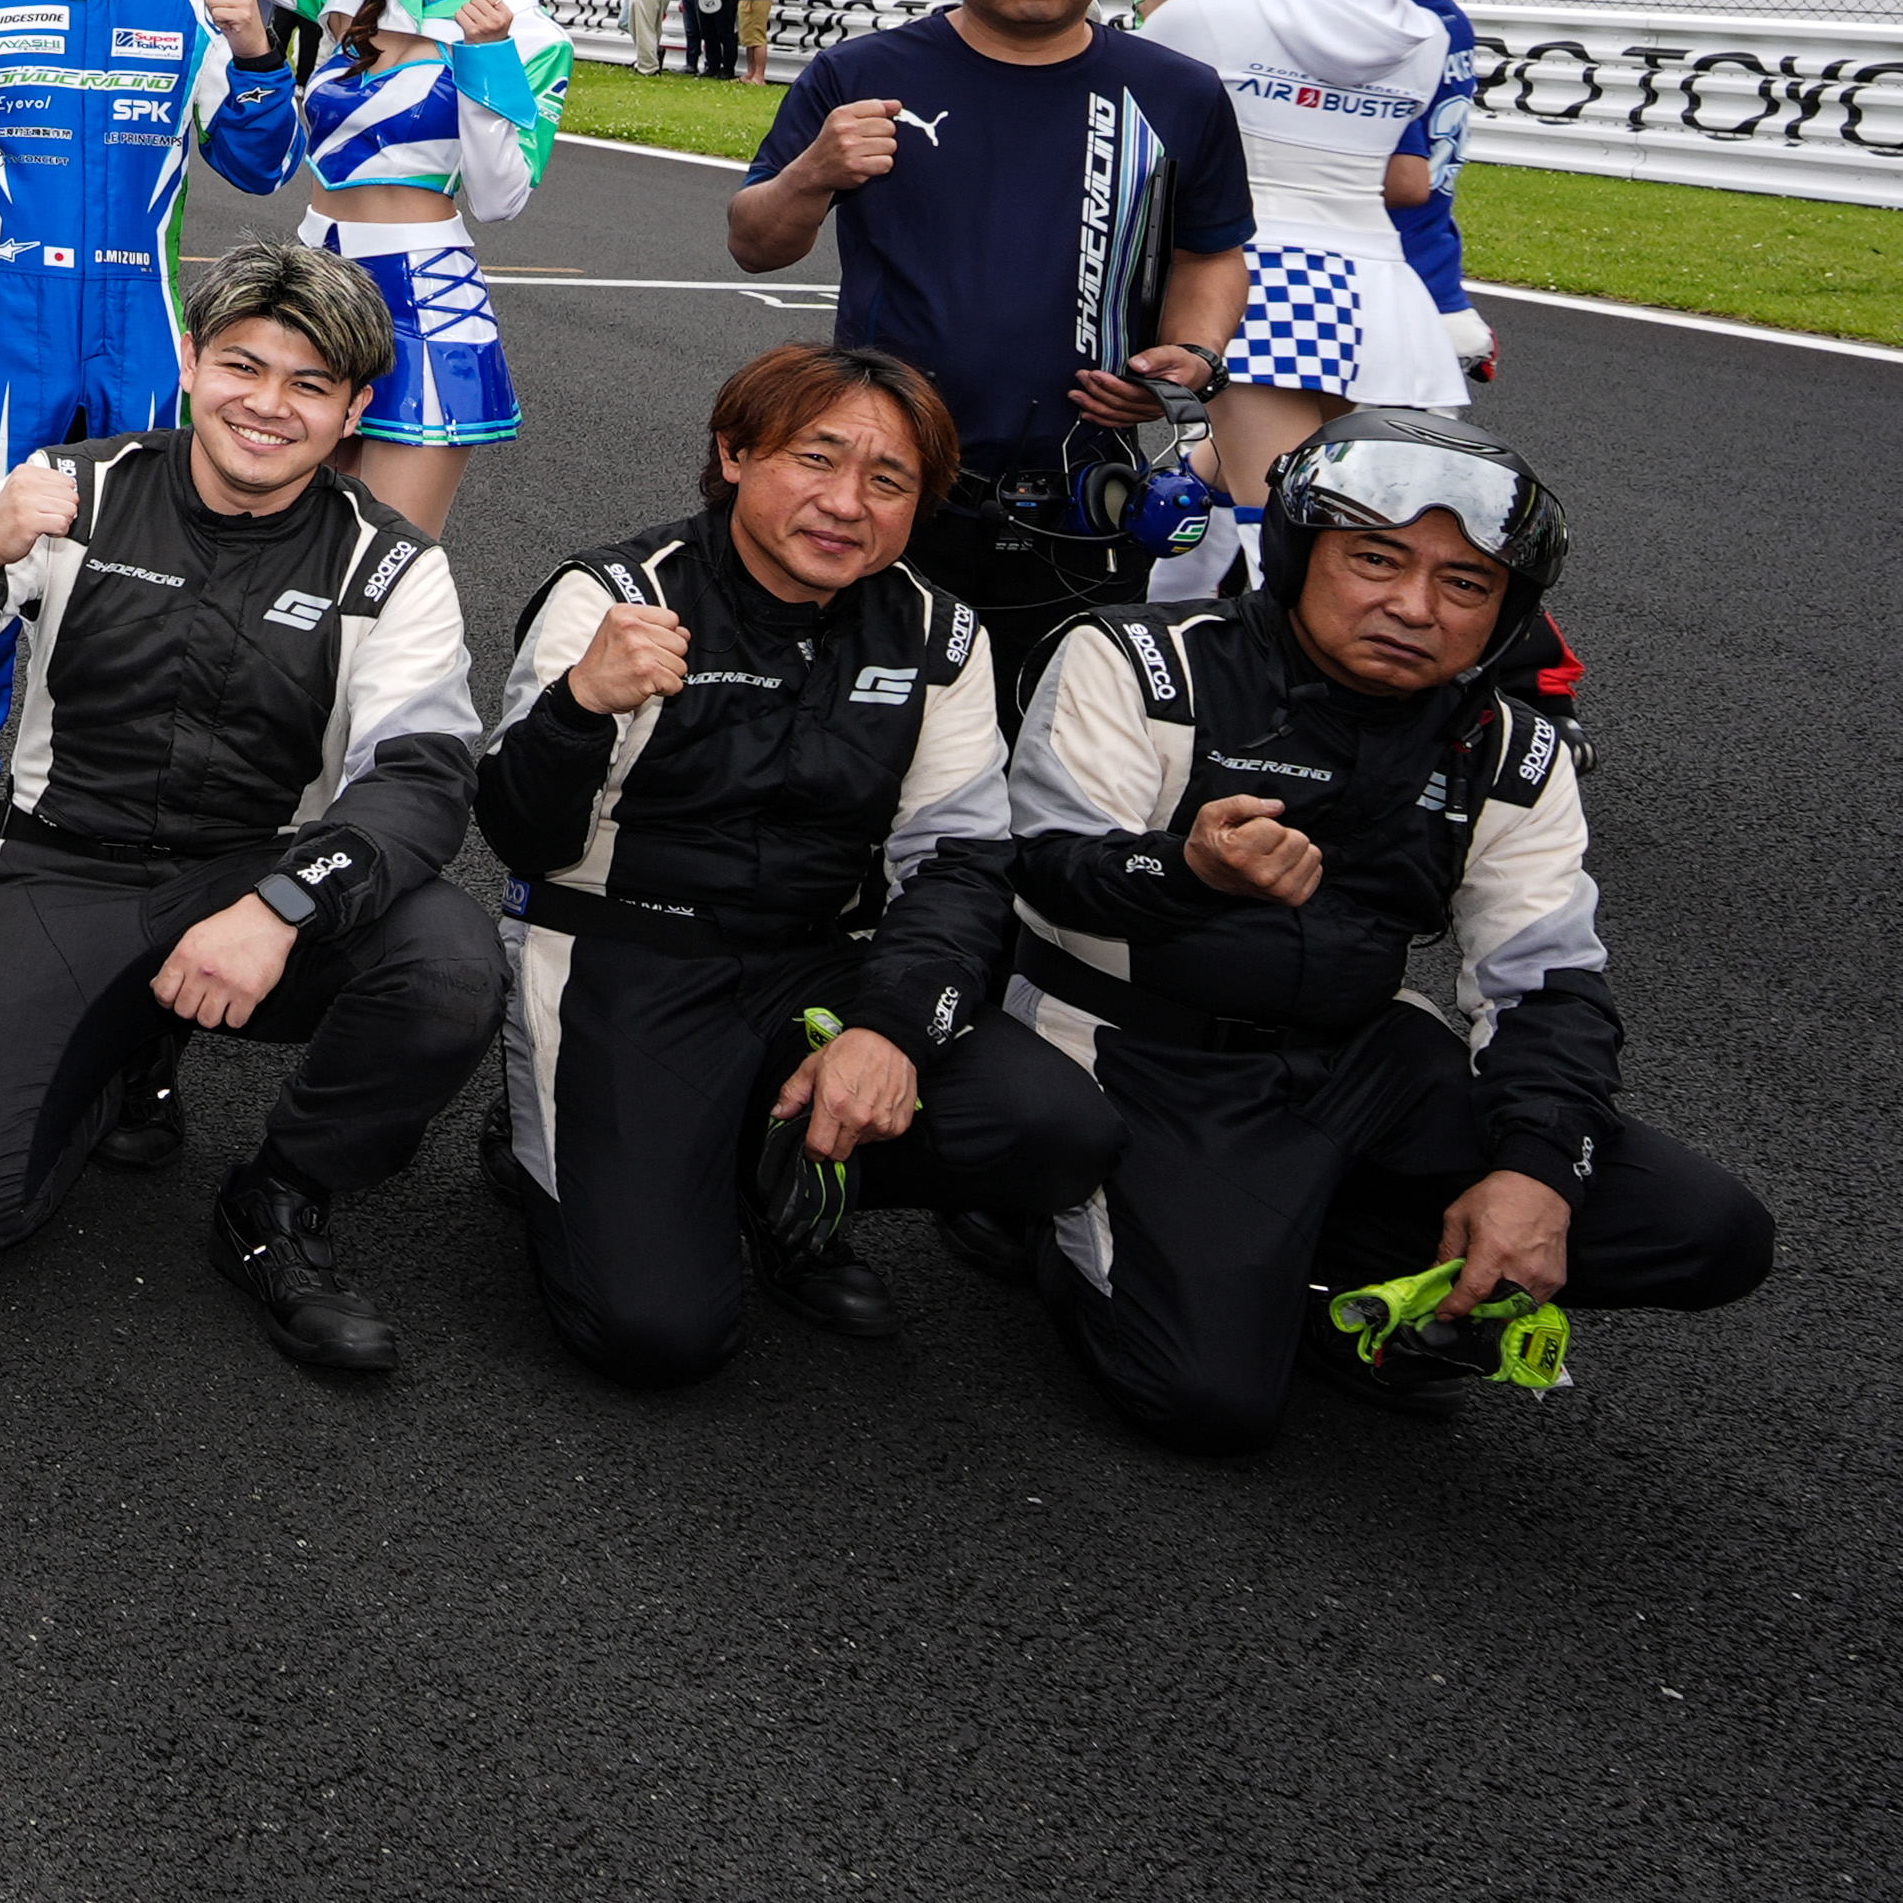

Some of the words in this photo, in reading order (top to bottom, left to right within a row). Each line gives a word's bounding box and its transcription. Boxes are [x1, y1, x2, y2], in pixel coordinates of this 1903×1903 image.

[135, 32, 180, 43] Super
[135, 40, 179, 51] Taikyu
[85, 72, 177, 90] RACING
[1236, 78, 1294, 103] AIR
[113, 99, 172, 123] SPK
[105, 132, 118, 144] LE
[120, 132, 183, 147] PRINTEMPS
[19, 156, 69, 166] CONCEPT
[1081, 92, 1118, 234] RACING
[95, 250, 150, 266] D.MIZUNO
[1075, 235, 1106, 361] SHADE
[133, 567, 186, 588] RACING
[363, 540, 418, 602] sparco
[945, 602, 980, 666] sparco
[1123, 621, 1176, 702] sparco
[721, 673, 783, 689] RACING
[1518, 716, 1558, 786] sparco
[1262, 758, 1333, 782] RACING
